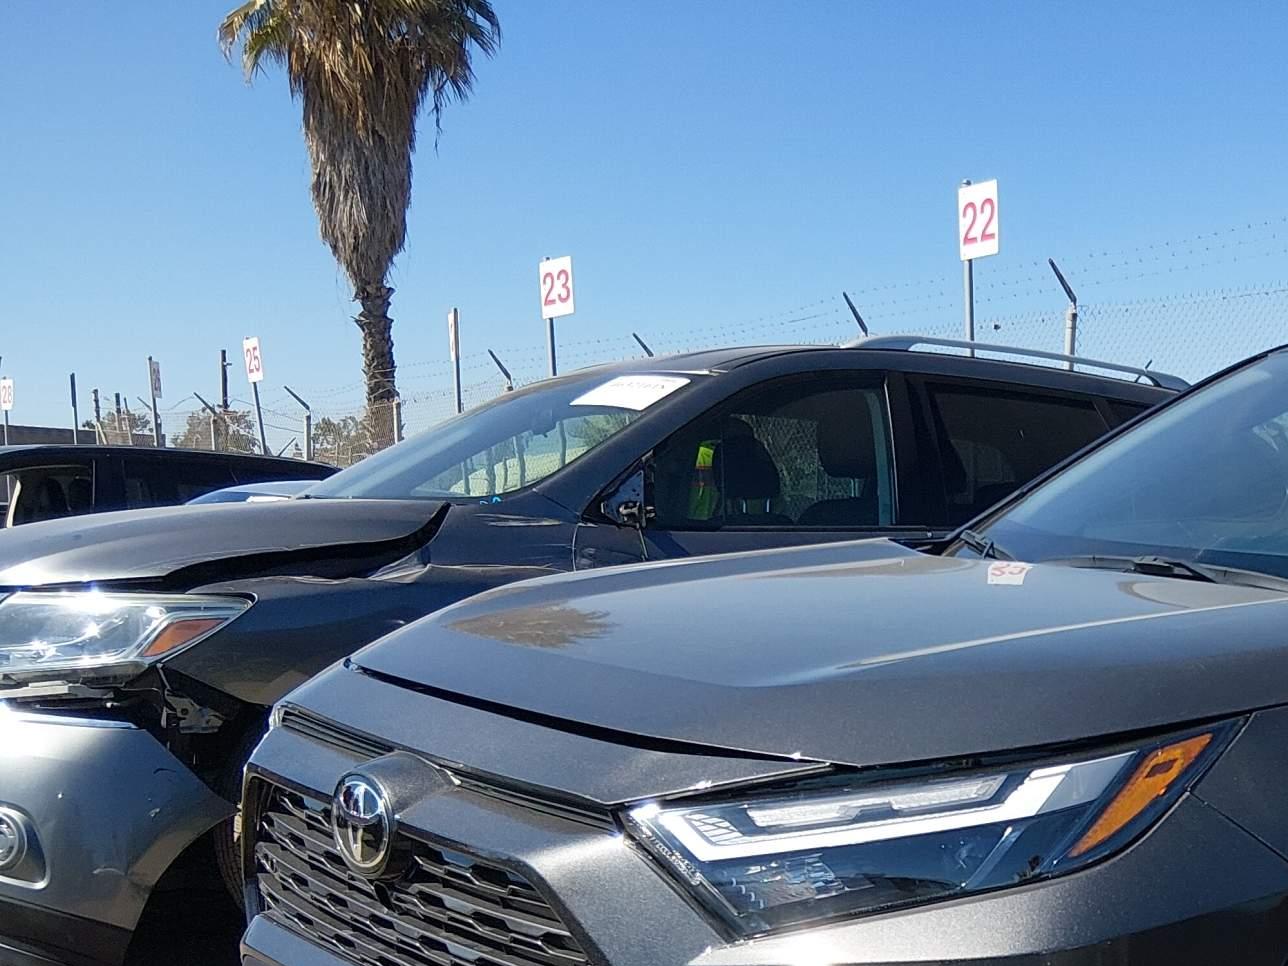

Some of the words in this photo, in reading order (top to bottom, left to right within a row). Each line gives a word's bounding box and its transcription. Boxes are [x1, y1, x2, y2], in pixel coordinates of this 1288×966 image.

[963, 198, 996, 245] 22
[543, 269, 571, 306] 23
[246, 346, 260, 374] 25
